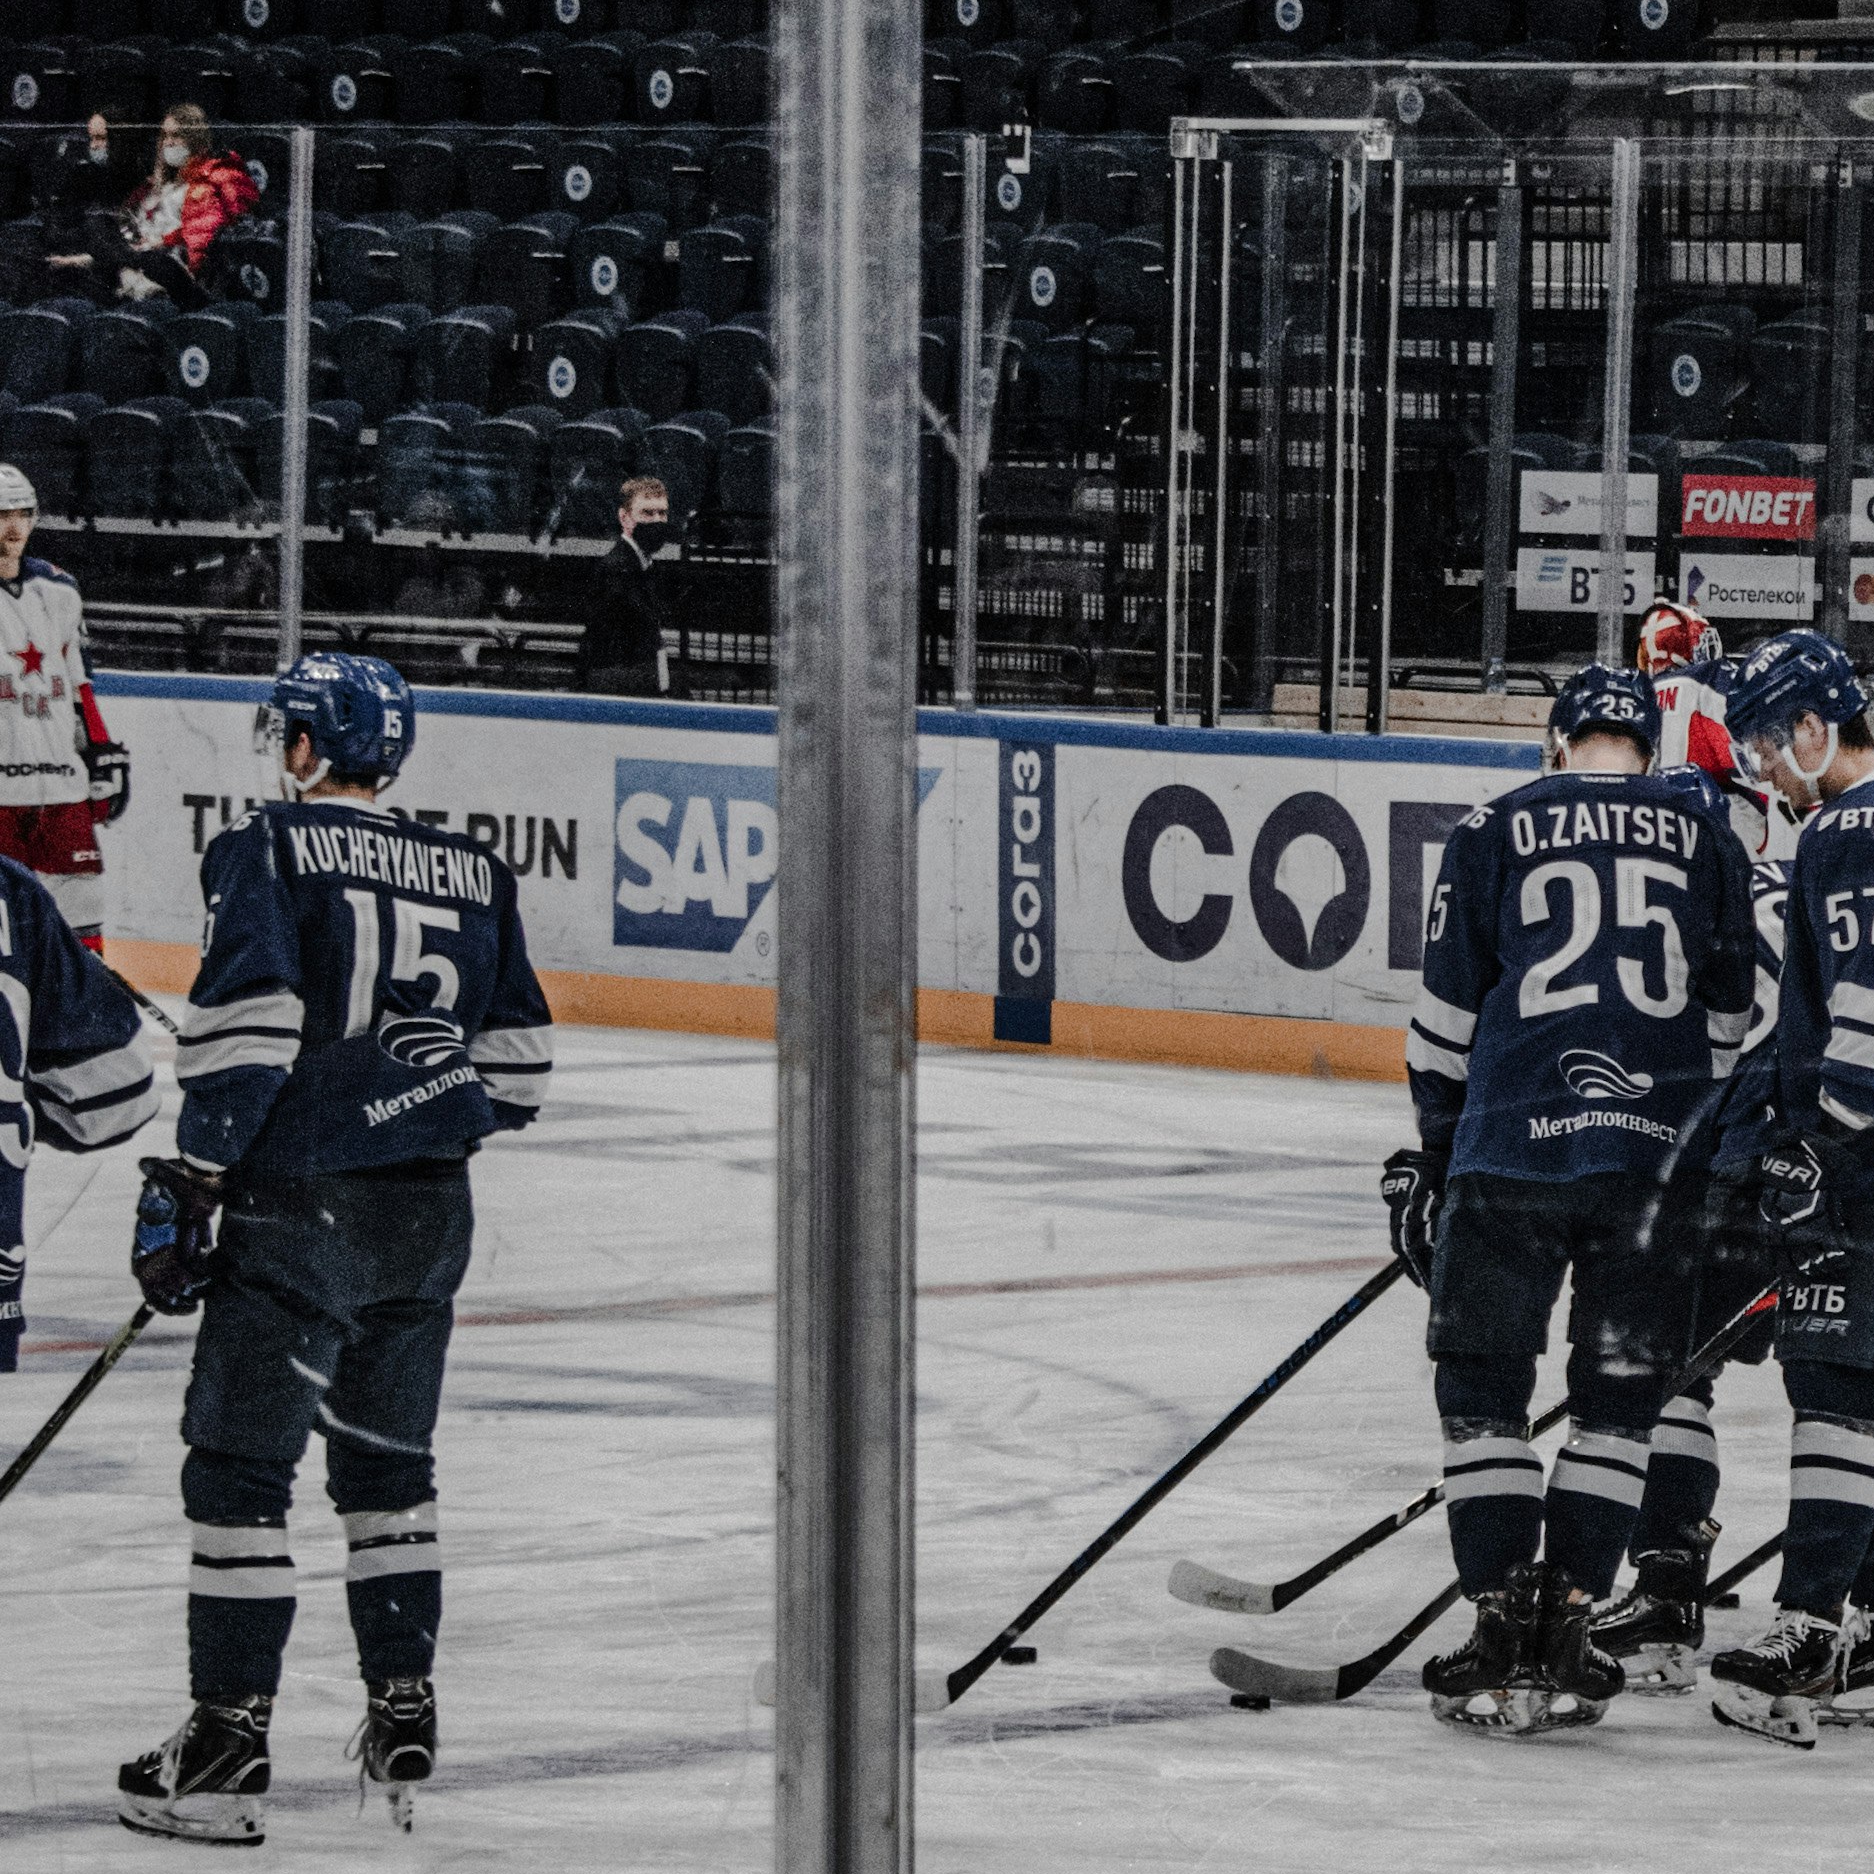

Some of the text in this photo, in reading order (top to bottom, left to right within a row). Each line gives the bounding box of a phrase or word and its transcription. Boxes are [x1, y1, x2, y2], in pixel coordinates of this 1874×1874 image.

[1684, 488, 1815, 526] FONBET
[1600, 694, 1638, 722] 25
[290, 826, 492, 906] KUCHERYAVENKO
[616, 792, 778, 919] SAP
[1511, 801, 1699, 861] O.ZAITSEV
[342, 887, 461, 1039] 15
[1517, 857, 1690, 1019] 25
